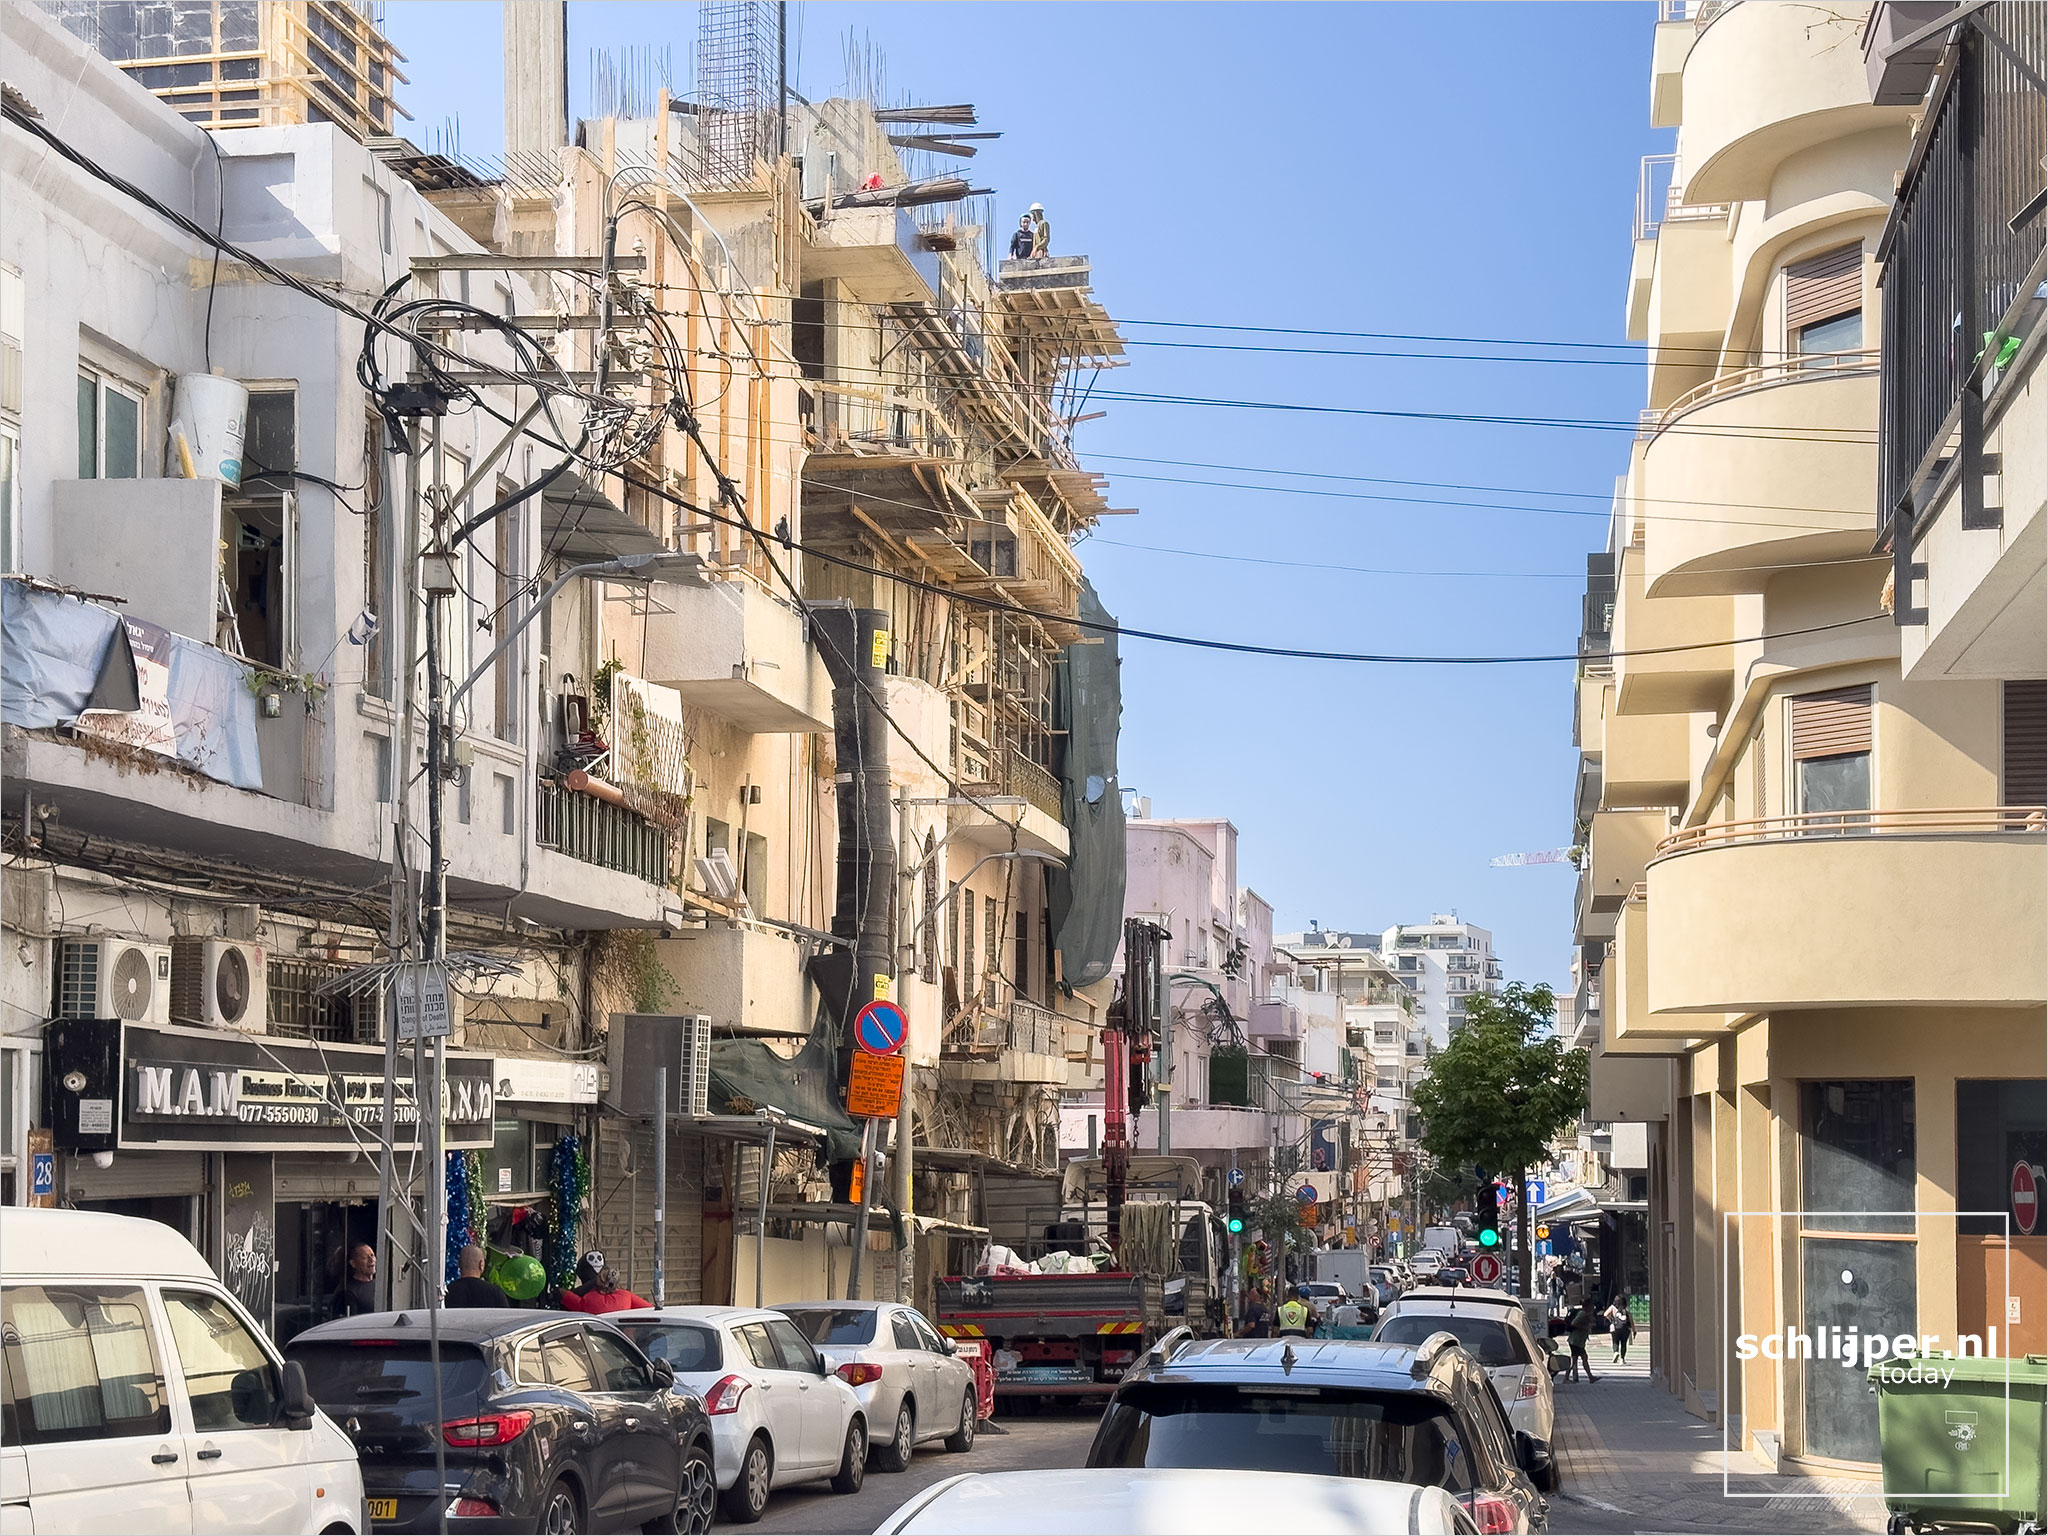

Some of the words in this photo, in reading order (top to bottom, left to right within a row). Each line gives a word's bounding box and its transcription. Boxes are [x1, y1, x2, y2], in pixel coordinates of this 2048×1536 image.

[424, 1002, 445, 1012] סכנת
[402, 1016, 421, 1025] Dang
[240, 1104, 319, 1123] 077-5550030
[36, 1161, 52, 1185] 28
